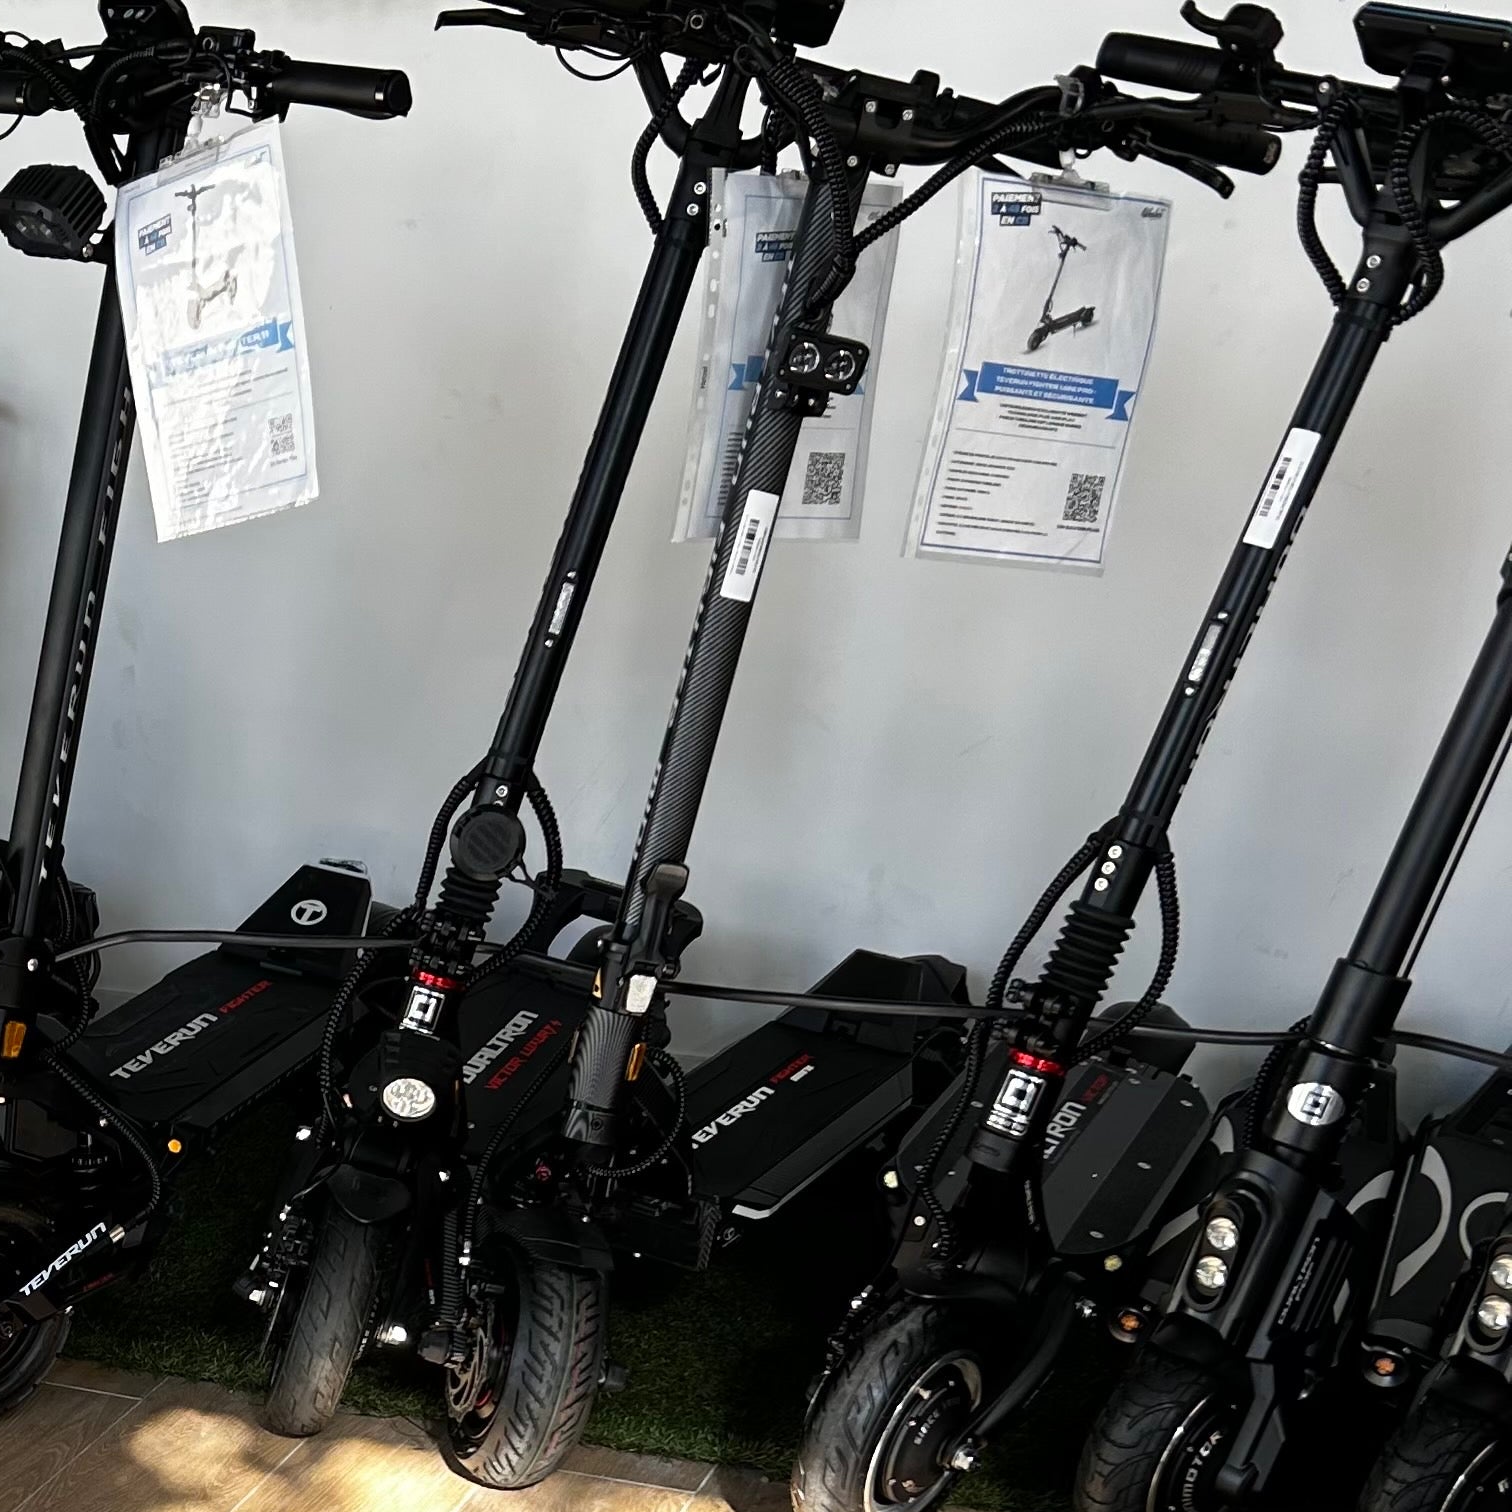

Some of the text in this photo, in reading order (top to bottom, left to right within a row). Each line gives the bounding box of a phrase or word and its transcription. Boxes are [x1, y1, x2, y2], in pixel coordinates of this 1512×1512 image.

[109, 1012, 219, 1079] TEVERUN
[484, 1056, 524, 1090] VICTOR
[691, 1086, 775, 1149] EVERUN
[19, 1222, 107, 1296] TEVERUN
